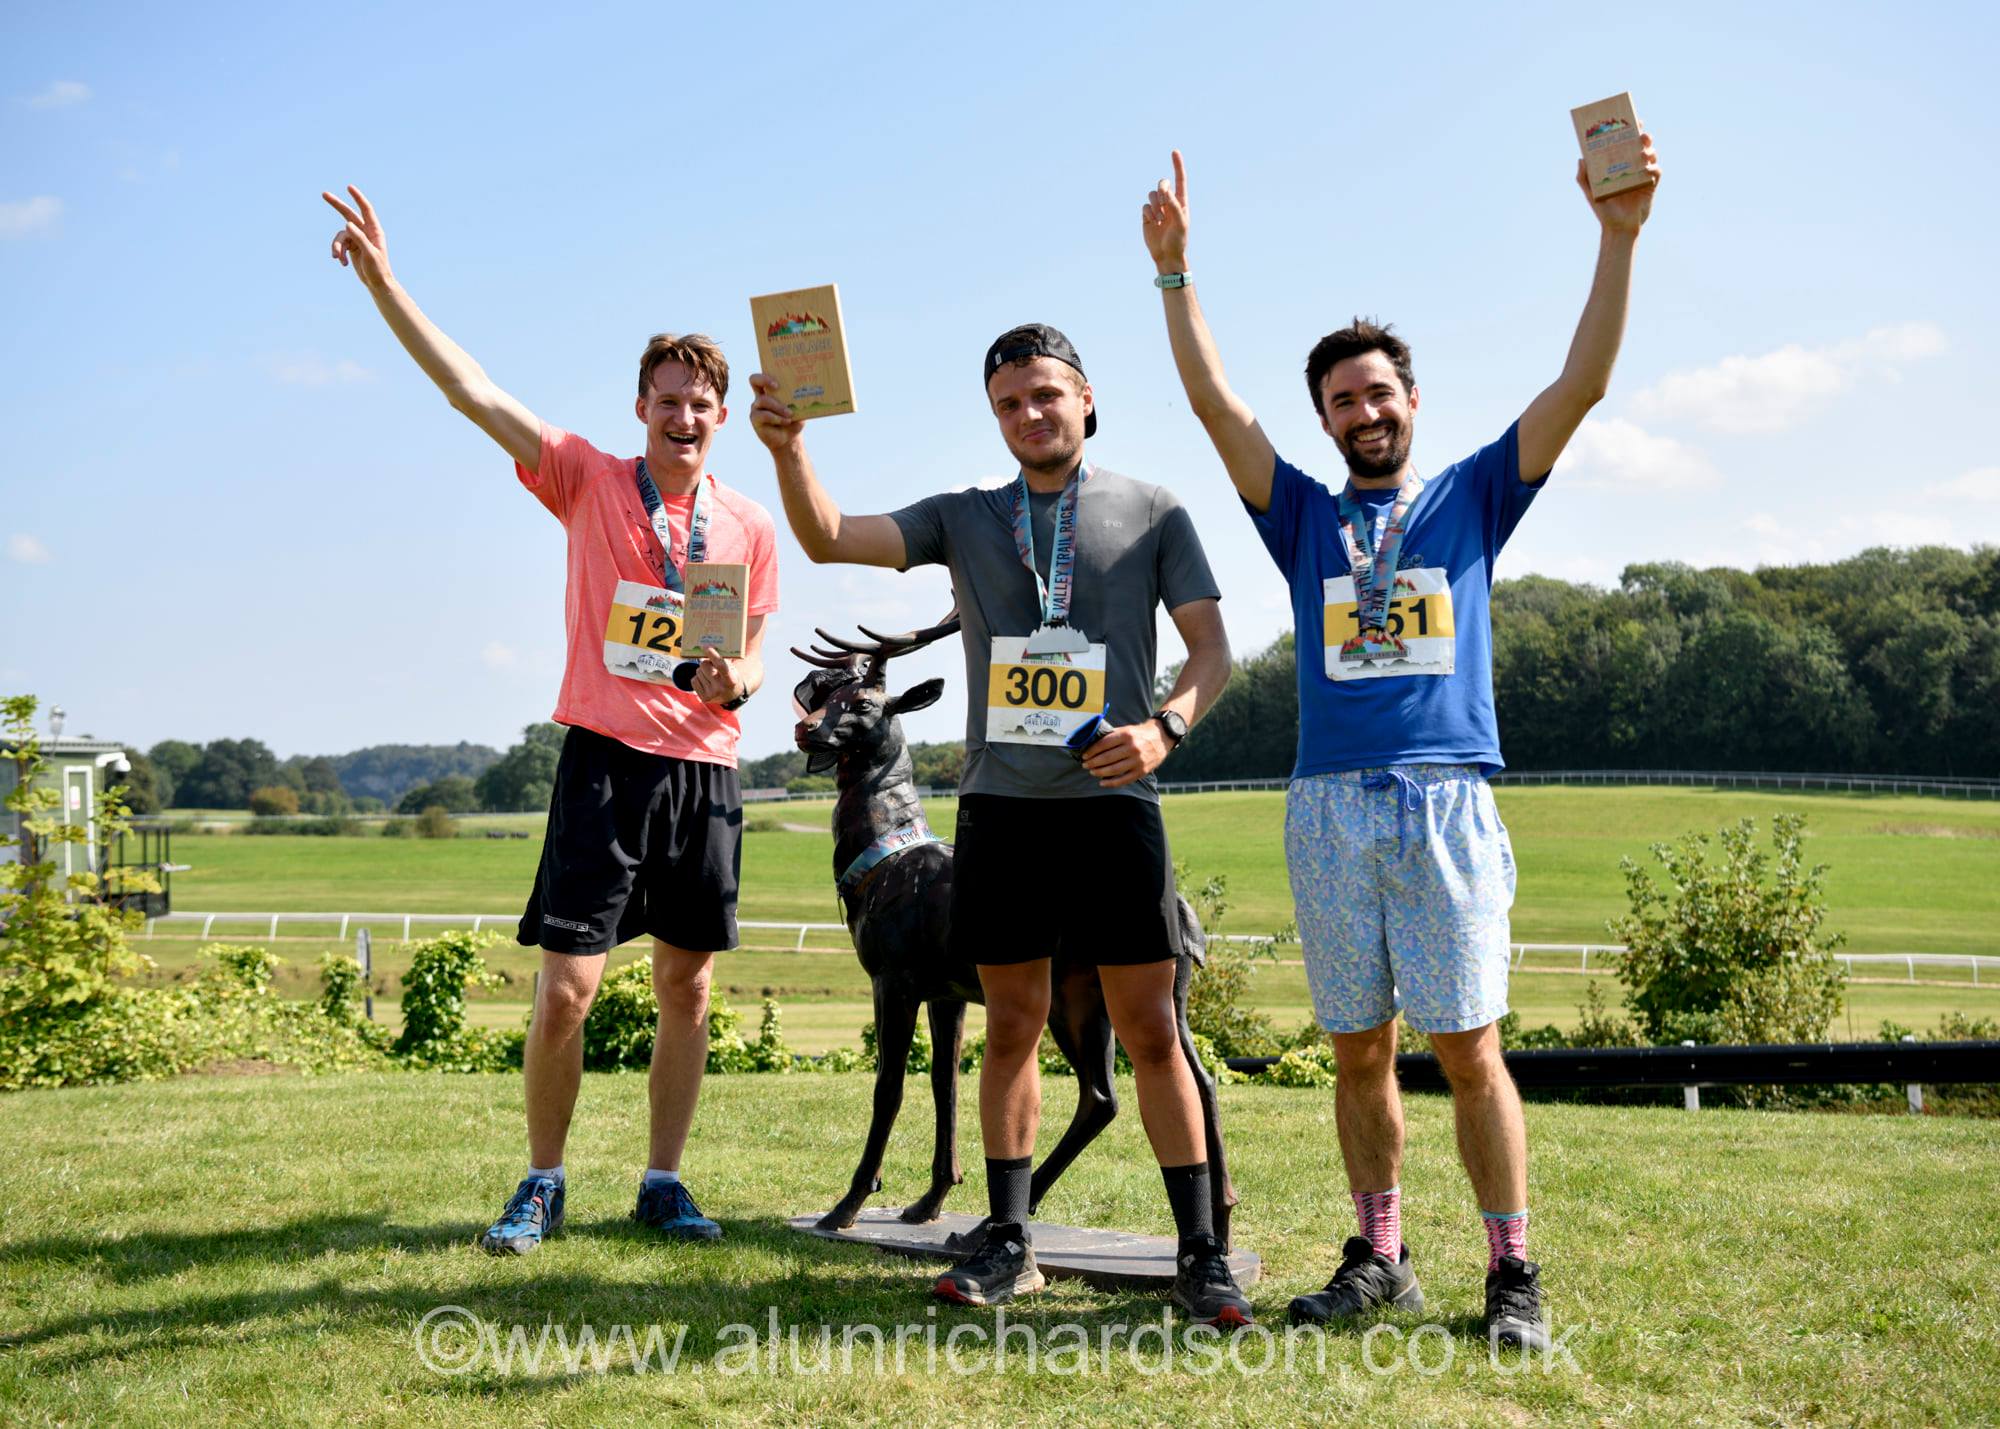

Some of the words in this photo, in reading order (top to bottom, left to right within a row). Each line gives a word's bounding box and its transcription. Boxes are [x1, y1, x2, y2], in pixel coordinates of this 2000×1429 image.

[694, 513, 708, 537] RACE
[1060, 502, 1075, 534] RACE
[1056, 535, 1073, 571] TRAIL
[1052, 571, 1070, 613] VALLEY
[1371, 588, 1388, 612] WYE
[1005, 666, 1087, 709] 300
[896, 829, 921, 845] RACE
